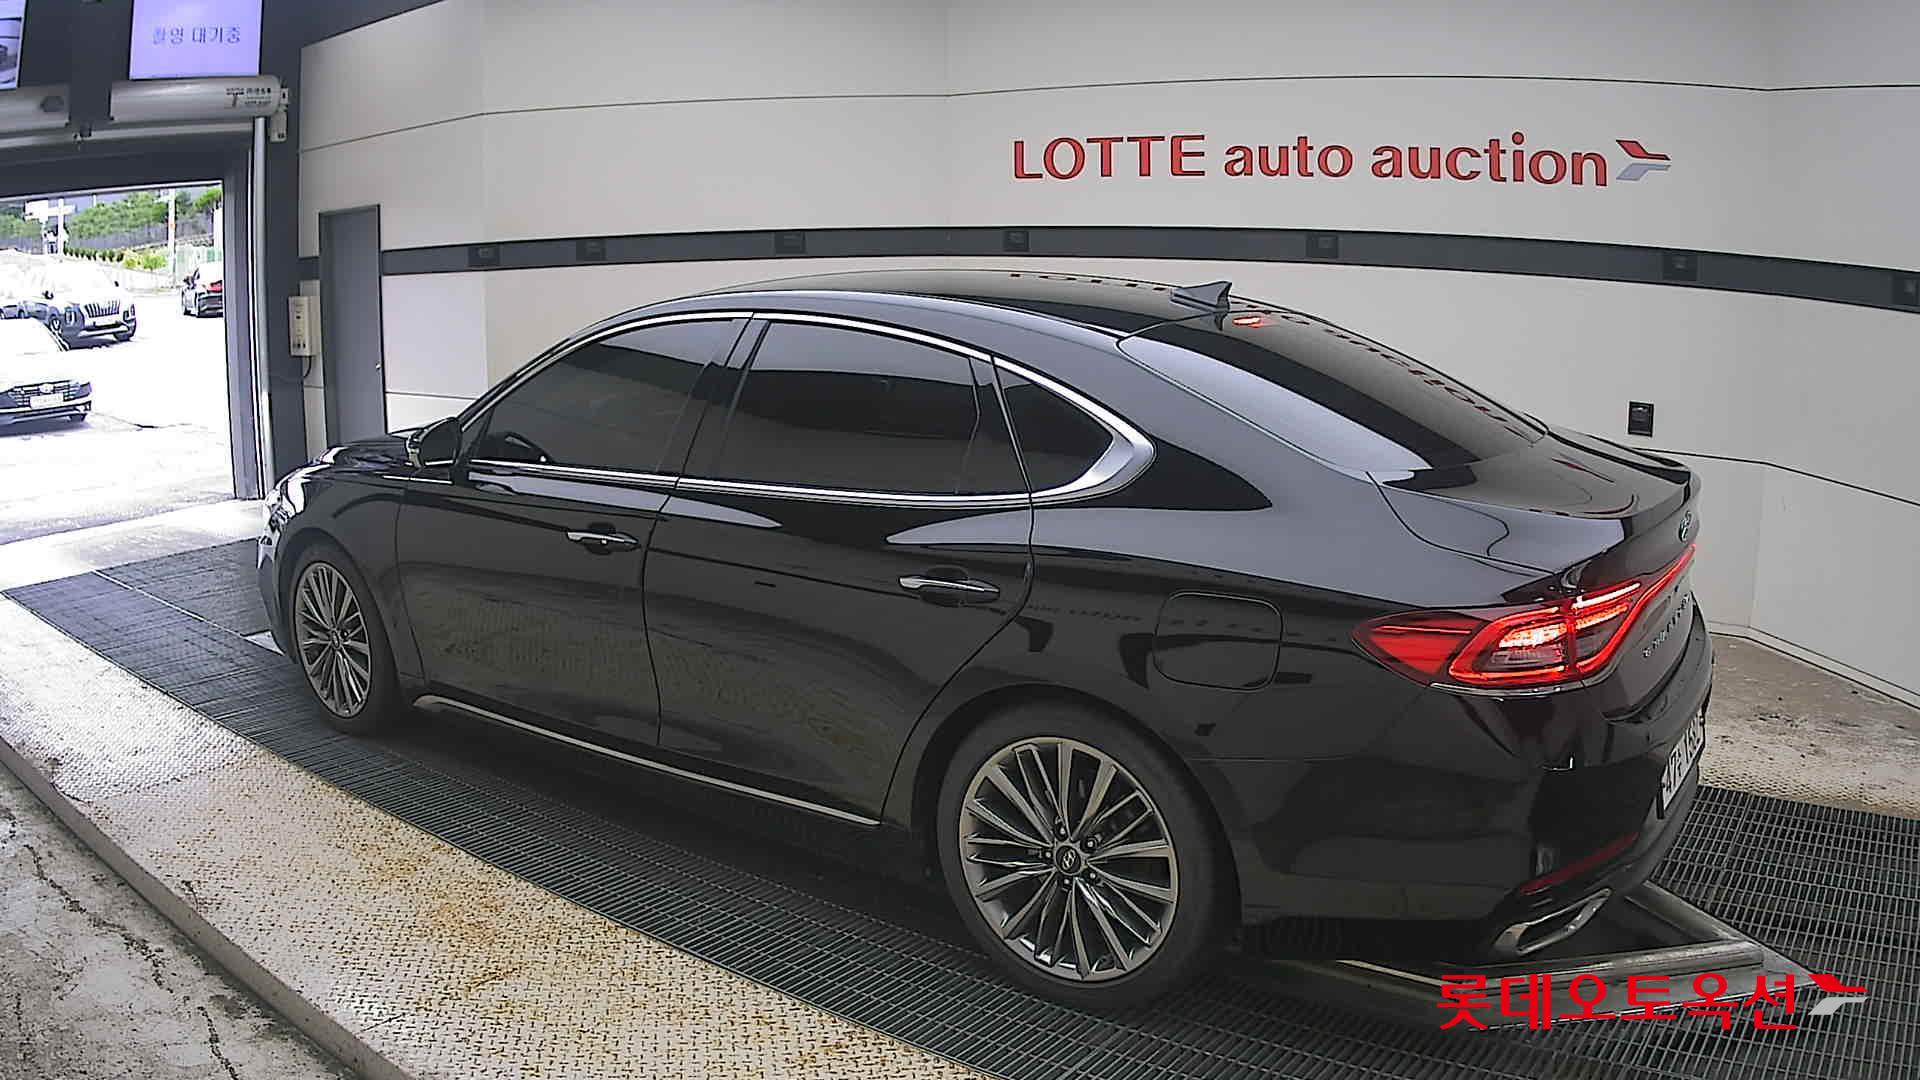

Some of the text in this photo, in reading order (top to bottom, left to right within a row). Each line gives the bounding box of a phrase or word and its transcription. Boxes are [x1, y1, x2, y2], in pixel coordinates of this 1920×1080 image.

[192, 26, 241, 44] 대기중
[1013, 131, 1608, 187] LOTTE auto auction
